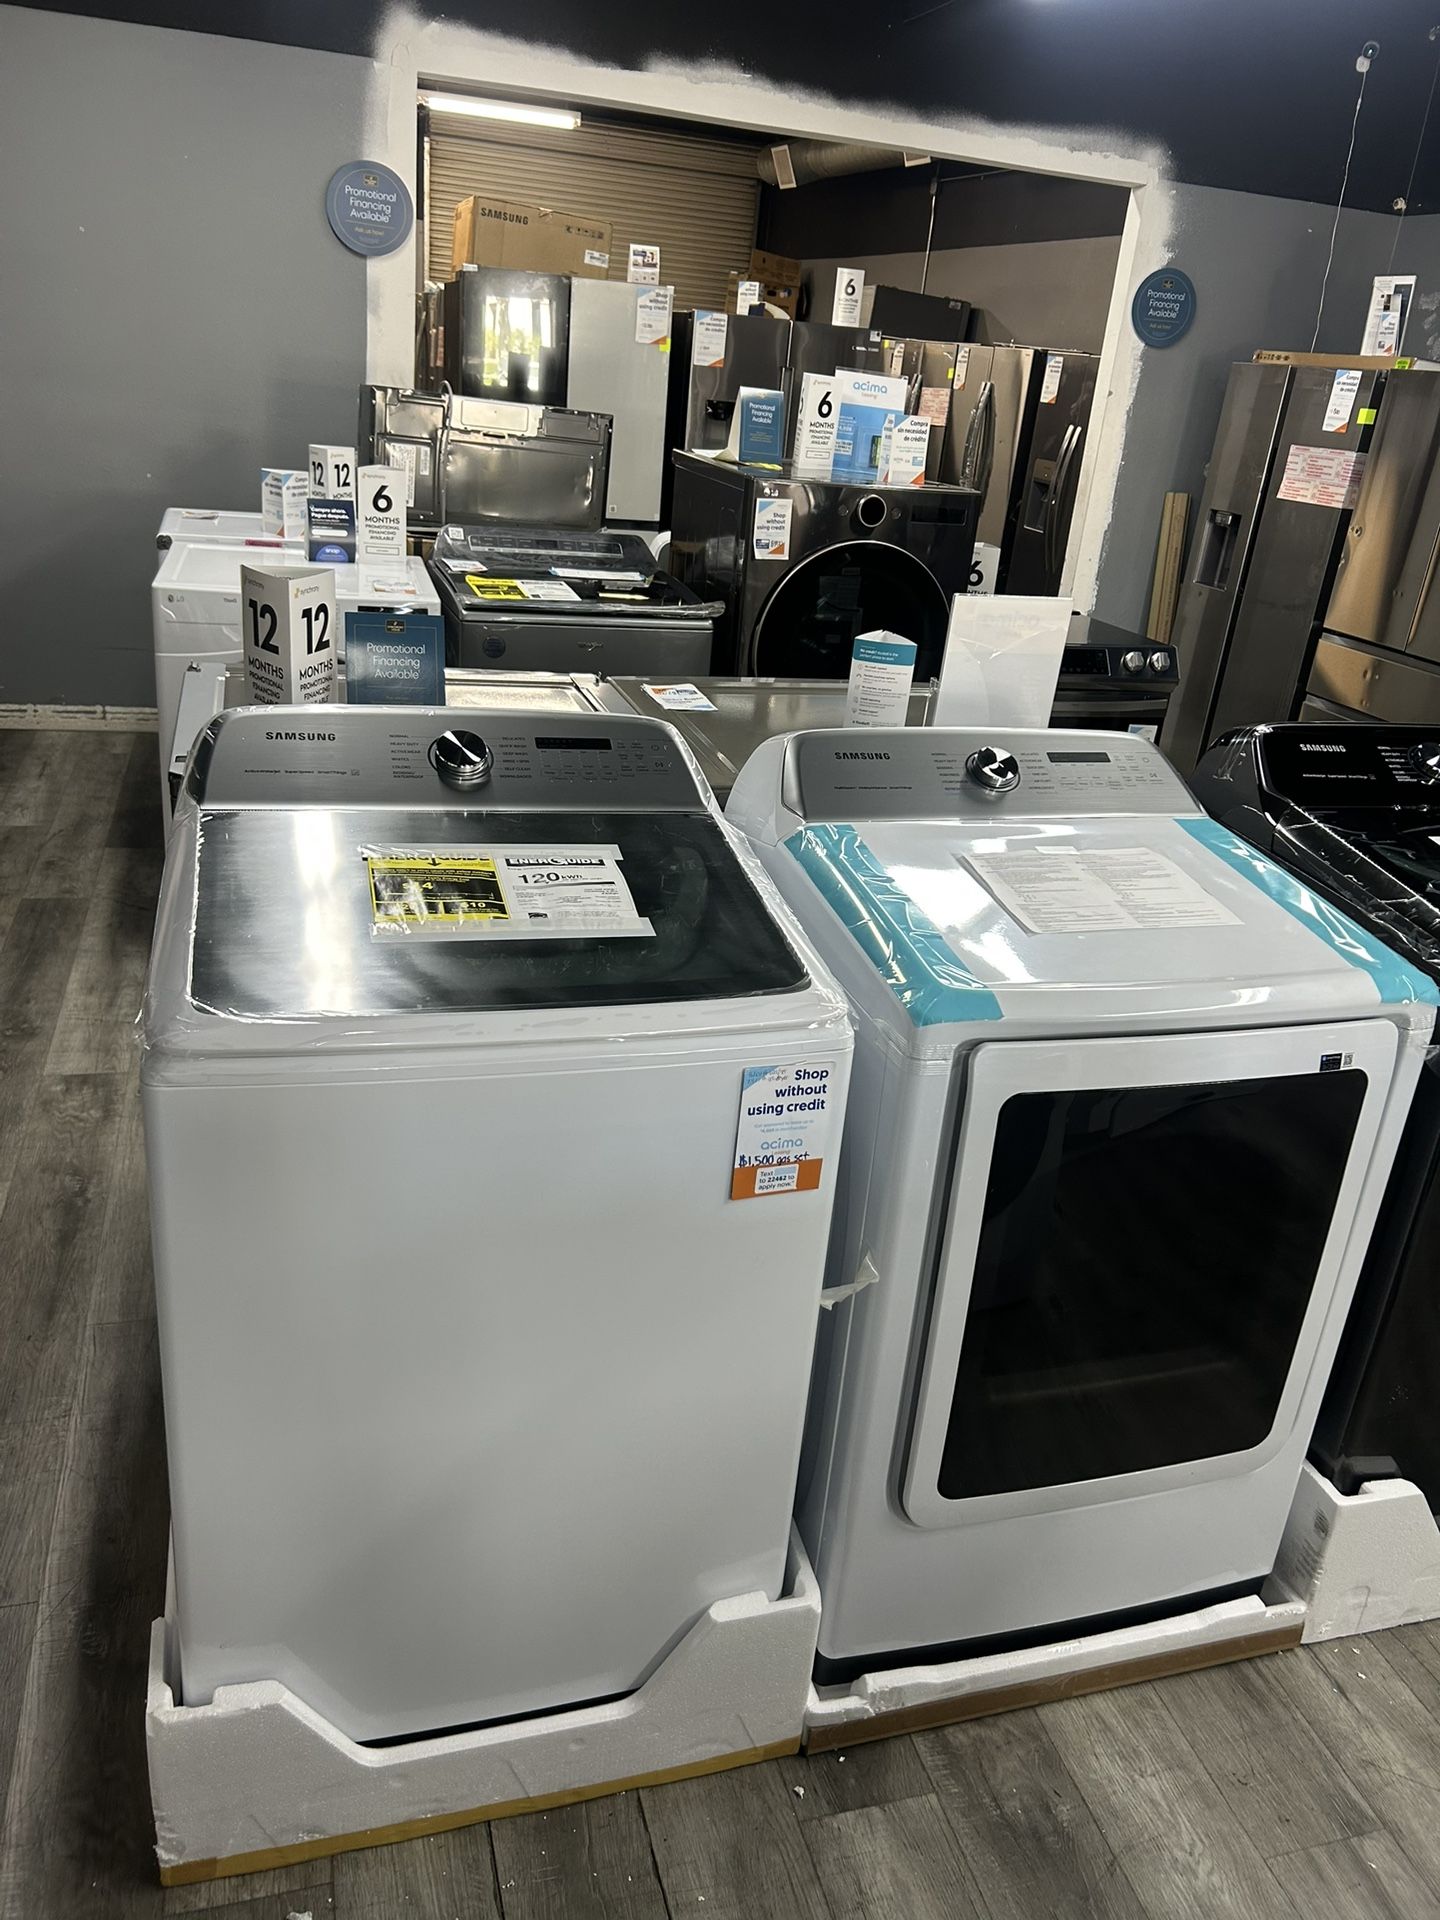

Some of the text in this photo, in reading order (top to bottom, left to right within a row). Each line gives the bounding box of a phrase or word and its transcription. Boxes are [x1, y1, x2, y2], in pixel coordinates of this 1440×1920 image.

[344, 184, 397, 202] Promotional
[349, 196, 392, 214] Financing
[480, 207, 529, 226] SAMSUNG
[844, 278, 856, 297] 6
[1147, 289, 1186, 301] Promotional
[1149, 298, 1180, 311] Financing
[853, 380, 888, 395] acima
[749, 402, 776, 412] Promotional
[817, 391, 832, 418] 6
[751, 410, 773, 419] Financing
[810, 421, 835, 429] MONTHS
[312, 461, 324, 488] 12
[334, 463, 350, 488] 12
[372, 485, 393, 513] 6
[365, 516, 400, 525] MONTHS
[968, 560, 984, 587] 6
[249, 598, 279, 655] 12
[301, 603, 330, 655] 12
[366, 642, 426, 655] Promotional
[248, 656, 284, 680] MONTHS
[299, 658, 333, 680] MONTHS
[373, 655, 420, 670] Financing
[249, 670, 284, 691] PROMOTIONAL
[300, 676, 333, 692] PROMOTIONAL
[253, 682, 281, 699] FINANCING
[304, 685, 331, 700] FINANCING
[265, 731, 336, 742] SAMSUNG
[1299, 743, 1347, 753] SAMSUNG
[834, 751, 891, 761] SAMSUNG
[518, 872, 560, 884] 120
[794, 1069, 829, 1081] Shop
[775, 1084, 827, 1097] without
[747, 1099, 825, 1116] using credit
[761, 1138, 803, 1150] acima
[739, 1151, 810, 1168] $1,500 gas set
[758, 1181, 776, 1190] apply
